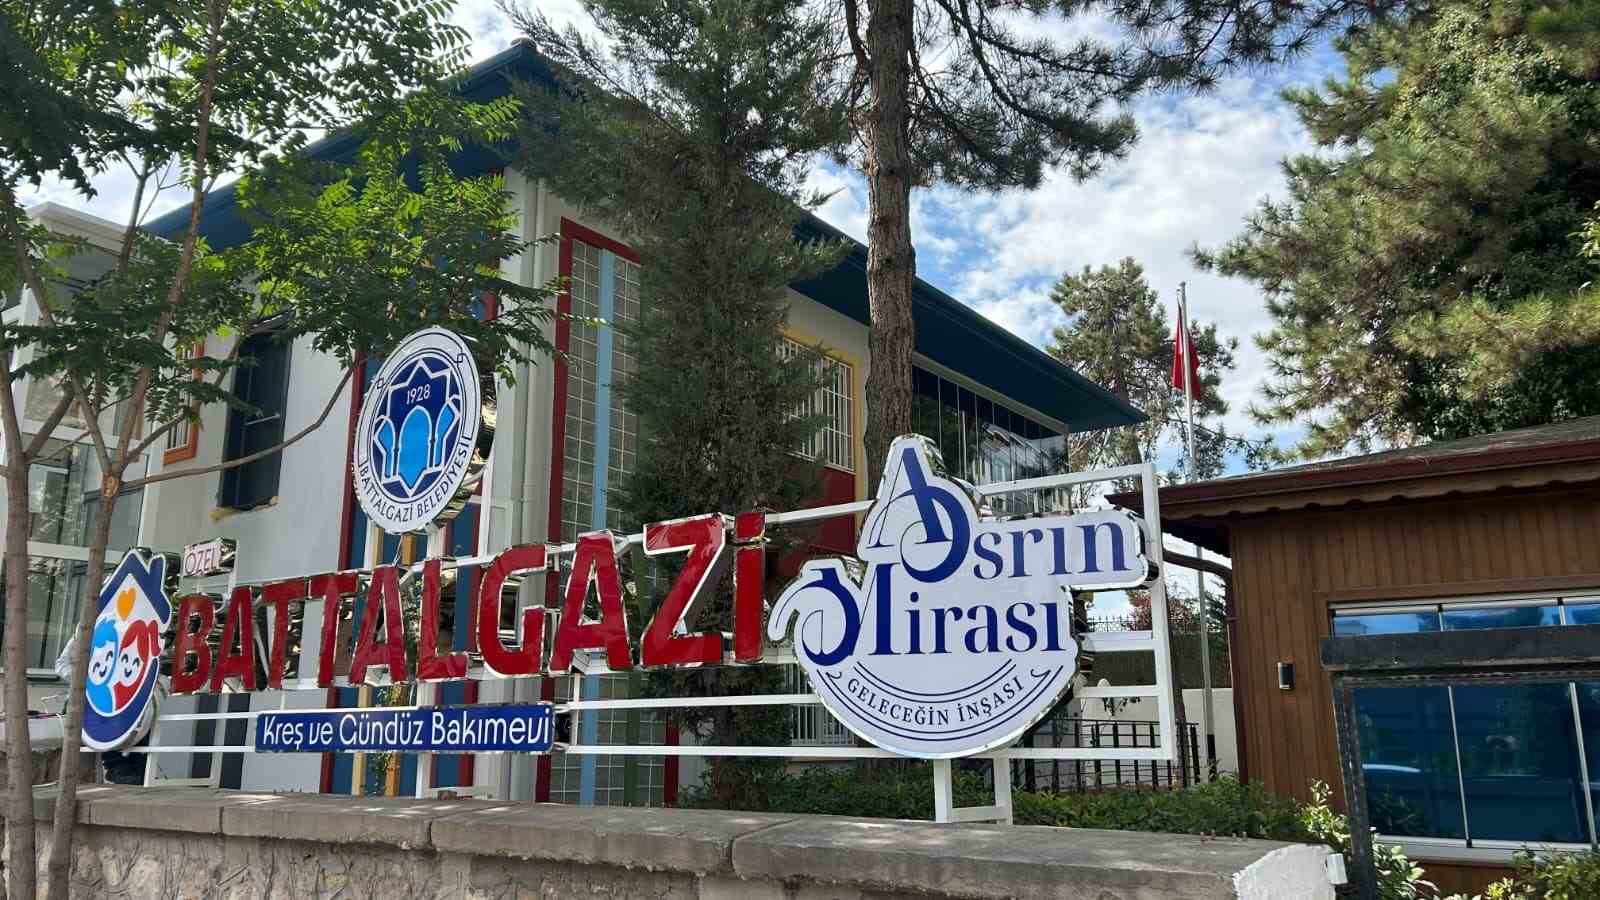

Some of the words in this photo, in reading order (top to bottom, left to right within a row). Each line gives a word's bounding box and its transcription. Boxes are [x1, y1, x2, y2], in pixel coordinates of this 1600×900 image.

[406, 383, 431, 404] 1928
[360, 466, 413, 522] BATTALGAZİ
[417, 439, 470, 518] BELEDİYESİ
[867, 447, 1132, 583] Asrın
[170, 512, 766, 695] BATTALGAZİ
[775, 562, 1064, 666] Mirası
[262, 715, 303, 749] Kreş
[308, 722, 333, 745] ve
[339, 713, 424, 746] Gündüz
[430, 708, 550, 745] Bakımevi
[847, 678, 949, 726] GELECEĞİN
[957, 676, 1024, 722] İNŞASI
